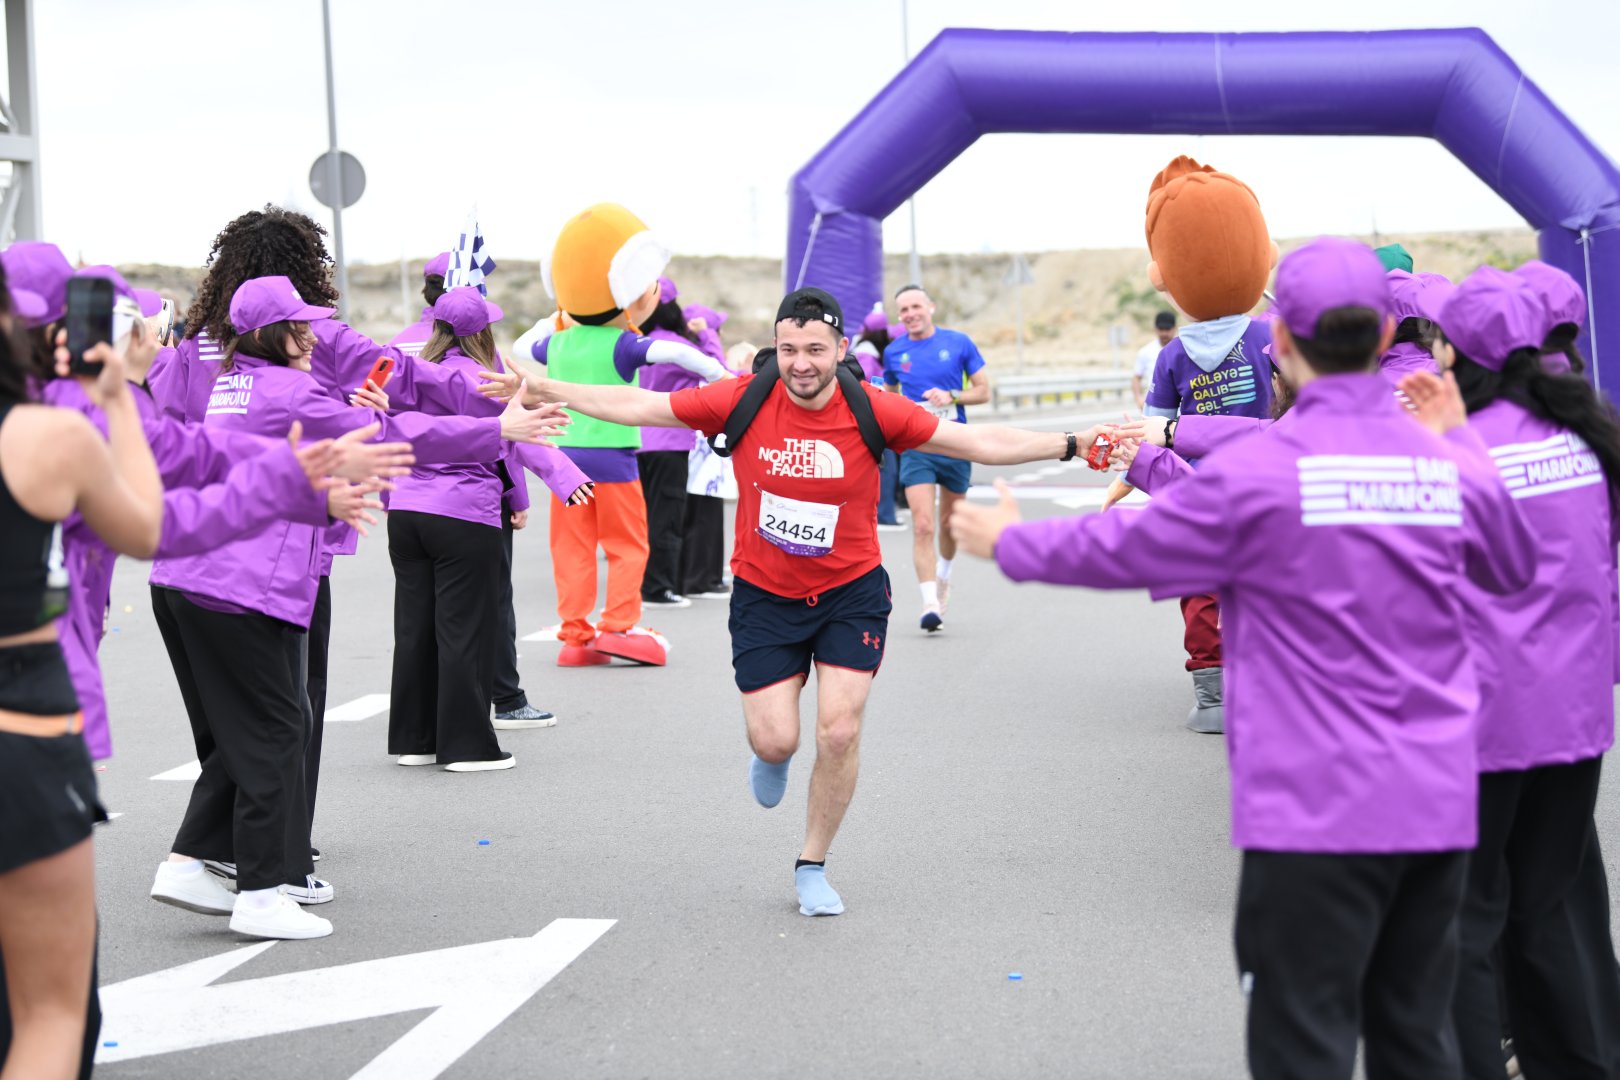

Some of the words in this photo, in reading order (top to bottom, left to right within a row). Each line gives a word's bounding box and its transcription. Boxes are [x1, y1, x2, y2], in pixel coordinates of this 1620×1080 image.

[1189, 369, 1238, 390] KÜLƏYƏ
[1196, 400, 1221, 413] GƏL
[783, 438, 815, 453] THE
[758, 446, 814, 465] NORTH
[771, 462, 814, 478] FACE
[765, 514, 827, 543] 24454
